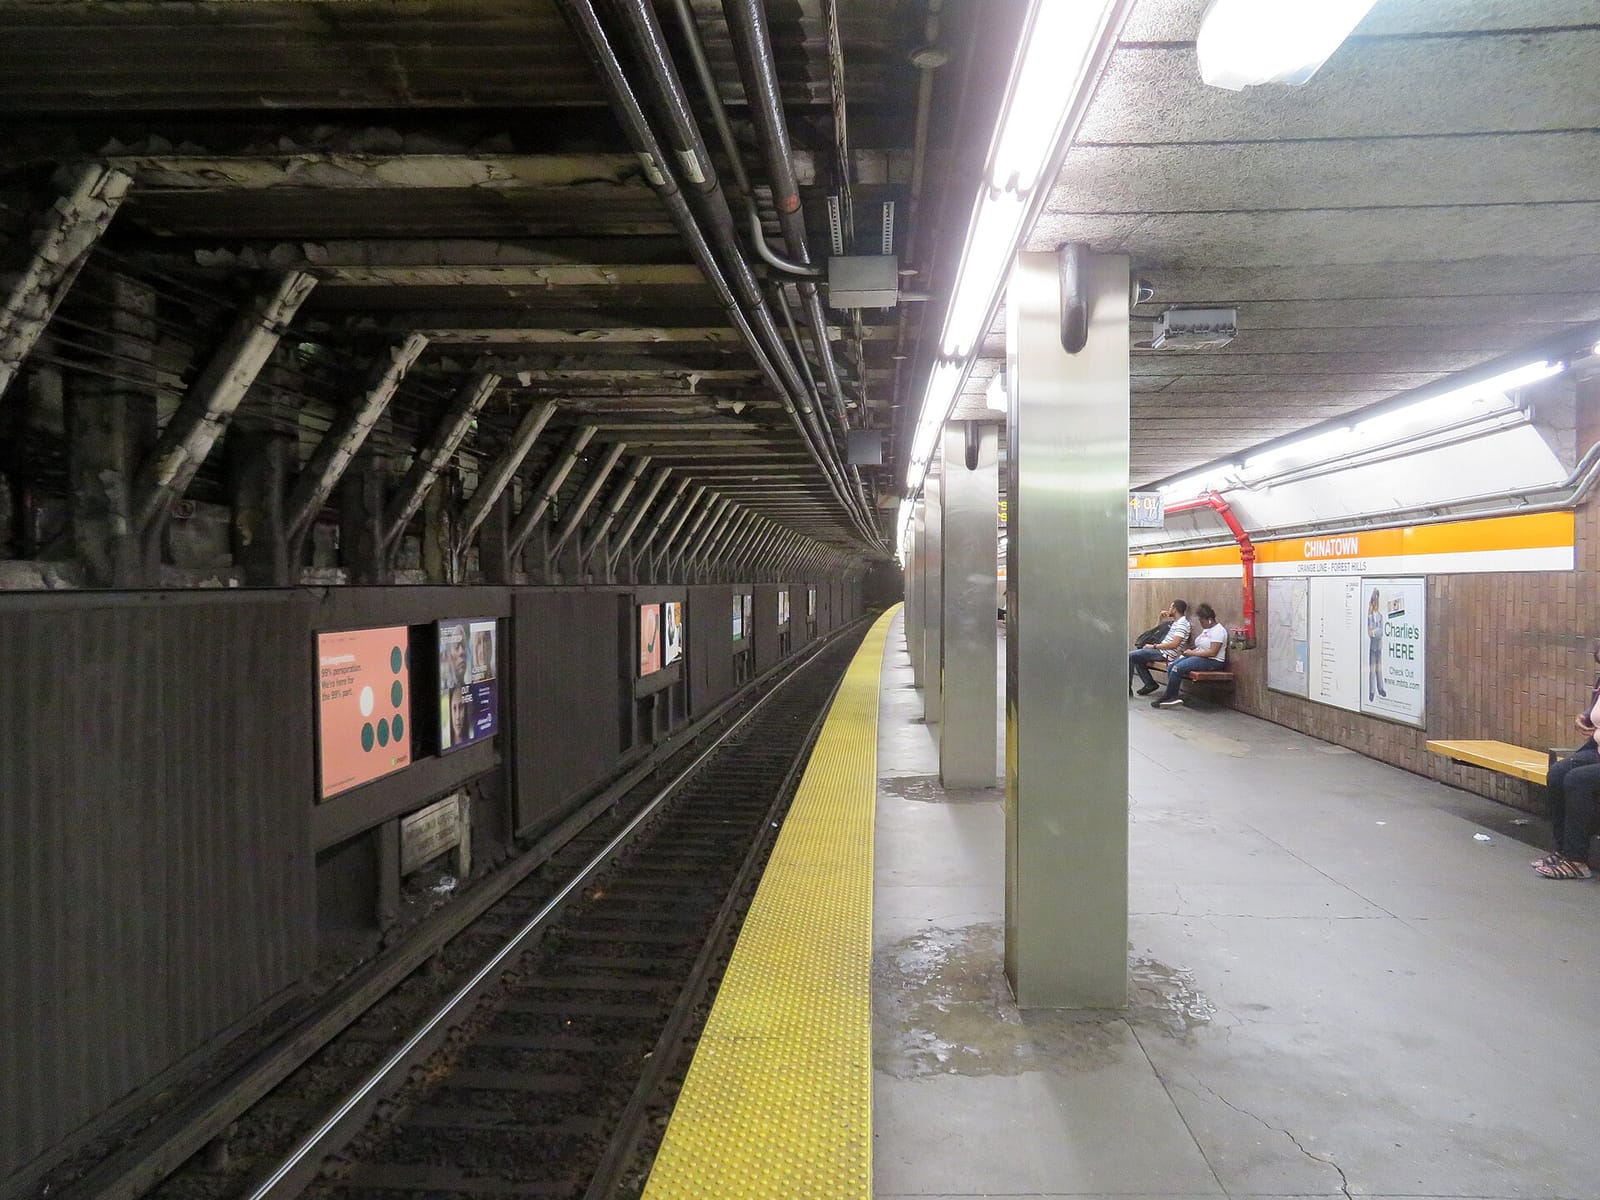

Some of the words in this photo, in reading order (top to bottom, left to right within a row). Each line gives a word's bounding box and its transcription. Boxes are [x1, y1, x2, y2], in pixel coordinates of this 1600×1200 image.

[1304, 537, 1359, 558] CHINATOWN
[1297, 563, 1316, 573] ORANGE
[1316, 563, 1327, 572] LINE
[1331, 562, 1350, 572] FOREST
[1351, 561, 1367, 571] HILLS
[1384, 622, 1420, 640] Charlie's
[1388, 643, 1414, 660] HERE
[1389, 666, 1404, 677] Check
[1404, 668, 1414, 678] Out
